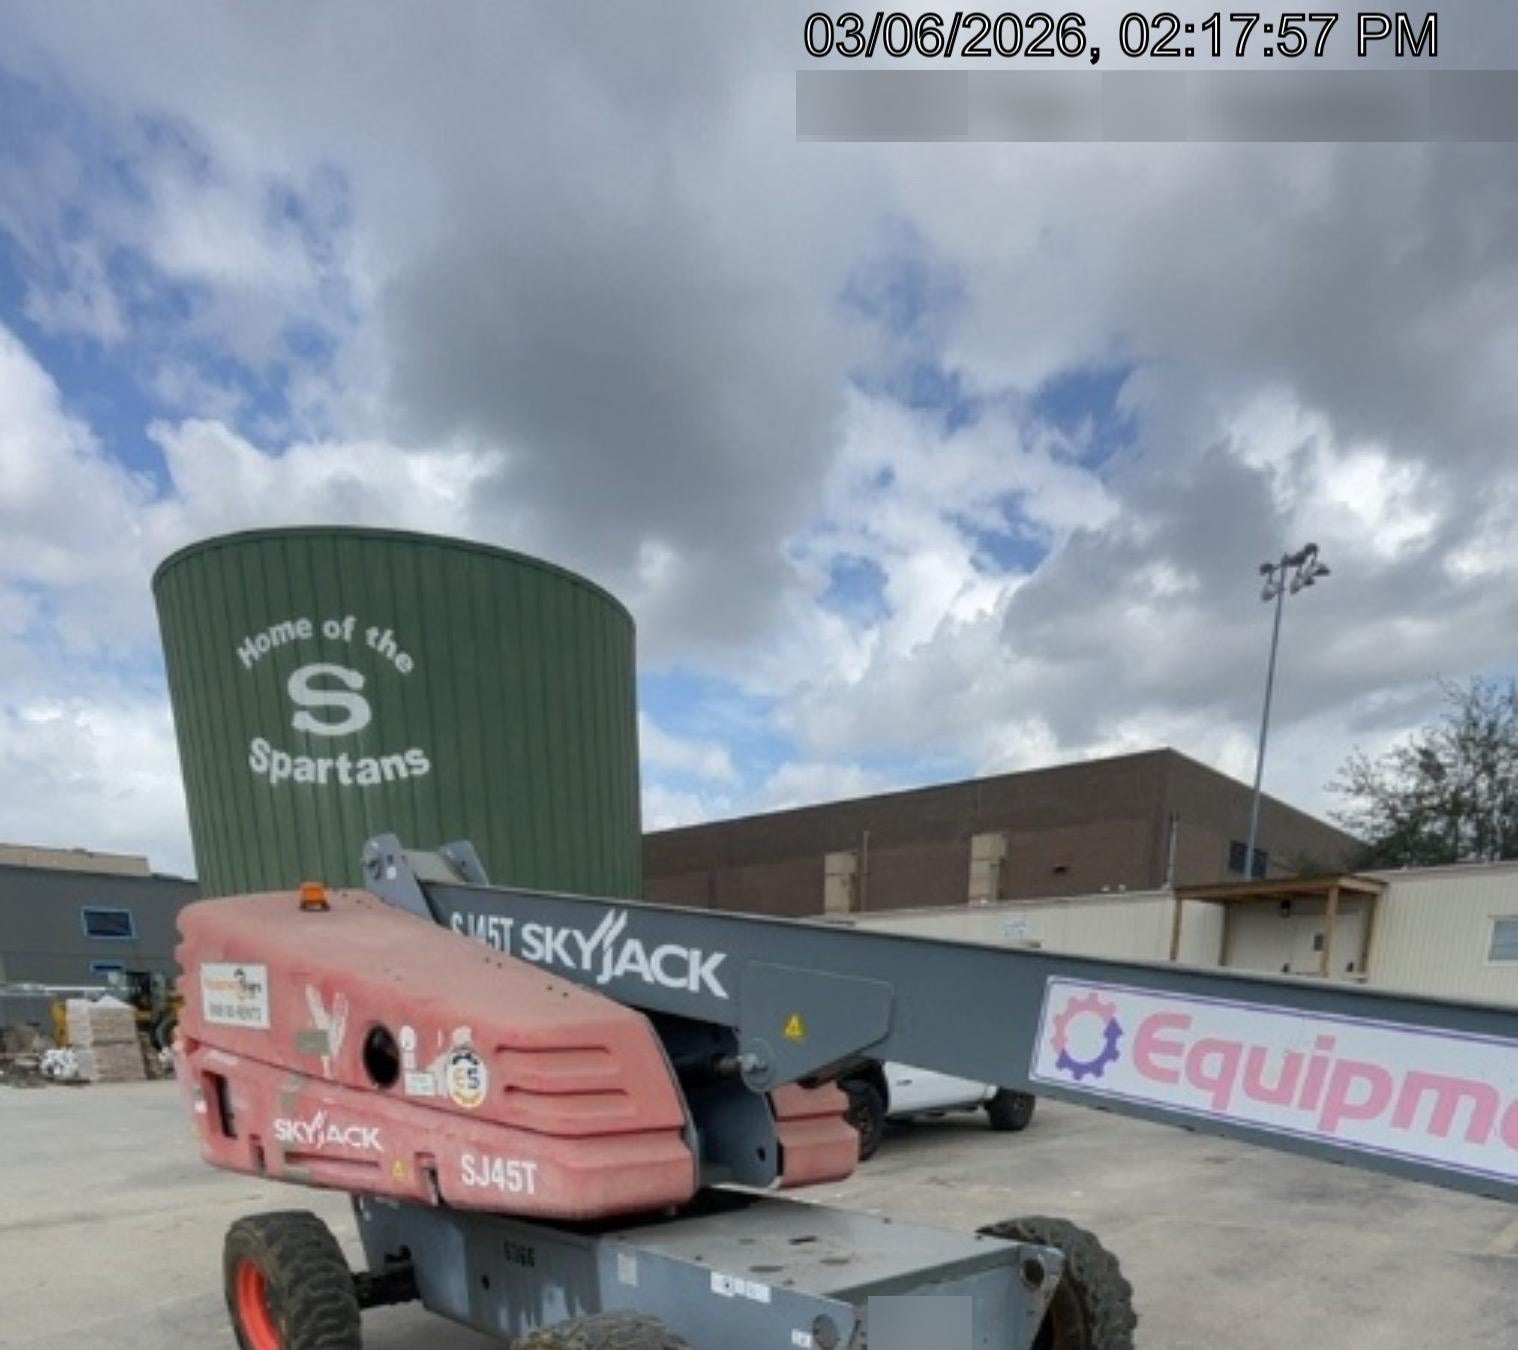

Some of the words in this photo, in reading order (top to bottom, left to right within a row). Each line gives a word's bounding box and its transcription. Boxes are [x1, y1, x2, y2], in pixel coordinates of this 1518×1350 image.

[237, 617, 313, 669] Home
[323, 615, 356, 642] of
[366, 626, 414, 673] the
[287, 662, 372, 736] S
[249, 737, 430, 785] Spartans
[520, 908, 729, 999] SKYJACK
[1132, 1012, 1518, 1150] Equipm
[273, 1110, 383, 1150] SKYJACK
[461, 1153, 537, 1195] SJ45T
